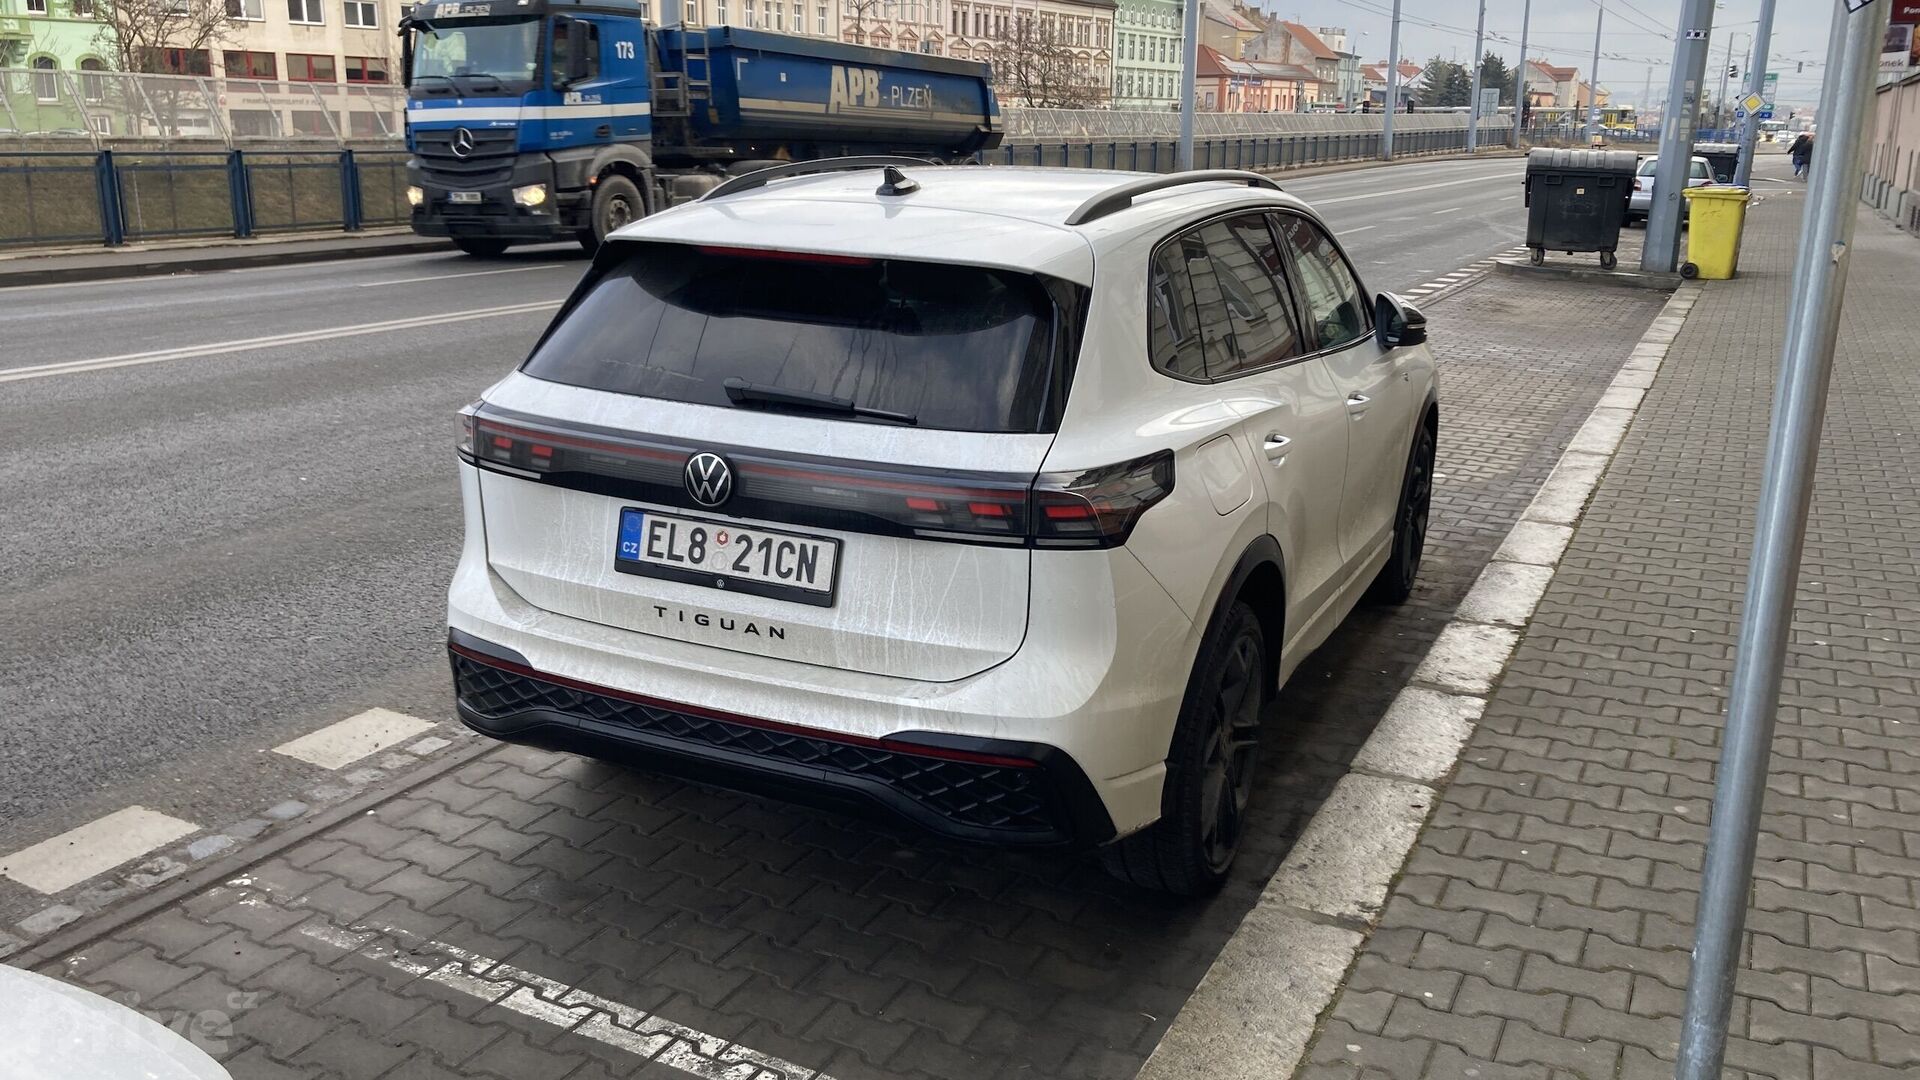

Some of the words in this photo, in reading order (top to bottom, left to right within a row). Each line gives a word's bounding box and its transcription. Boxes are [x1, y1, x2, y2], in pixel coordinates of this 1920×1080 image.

[615, 41, 635, 59] 173
[829, 65, 881, 114] APB
[892, 84, 933, 109] PLZEŇ
[622, 541, 638, 555] CZ
[647, 520, 708, 564] EL8
[732, 534, 819, 584] 21CN
[653, 604, 786, 640] TIGUAN
